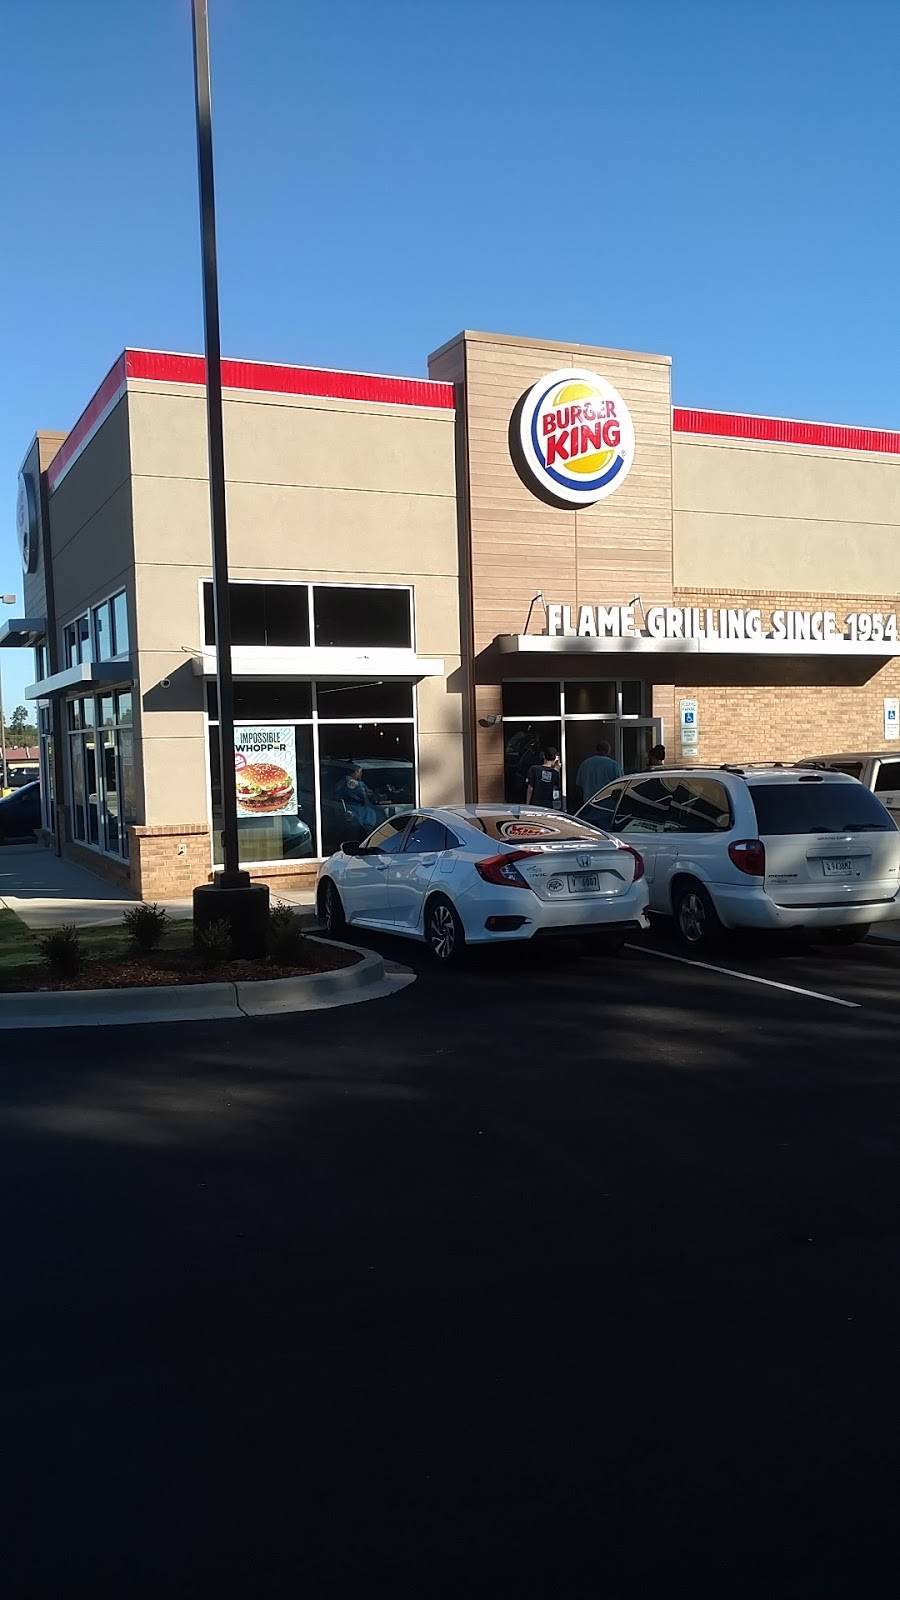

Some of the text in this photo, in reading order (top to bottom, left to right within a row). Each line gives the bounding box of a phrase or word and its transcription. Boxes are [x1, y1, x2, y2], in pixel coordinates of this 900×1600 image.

[543, 401, 617, 436] BURGER
[547, 419, 621, 466] KING
[548, 604, 897, 641] FLAME GRILLING SINCE 1954
[240, 732, 281, 744] IMPOSSIBLE
